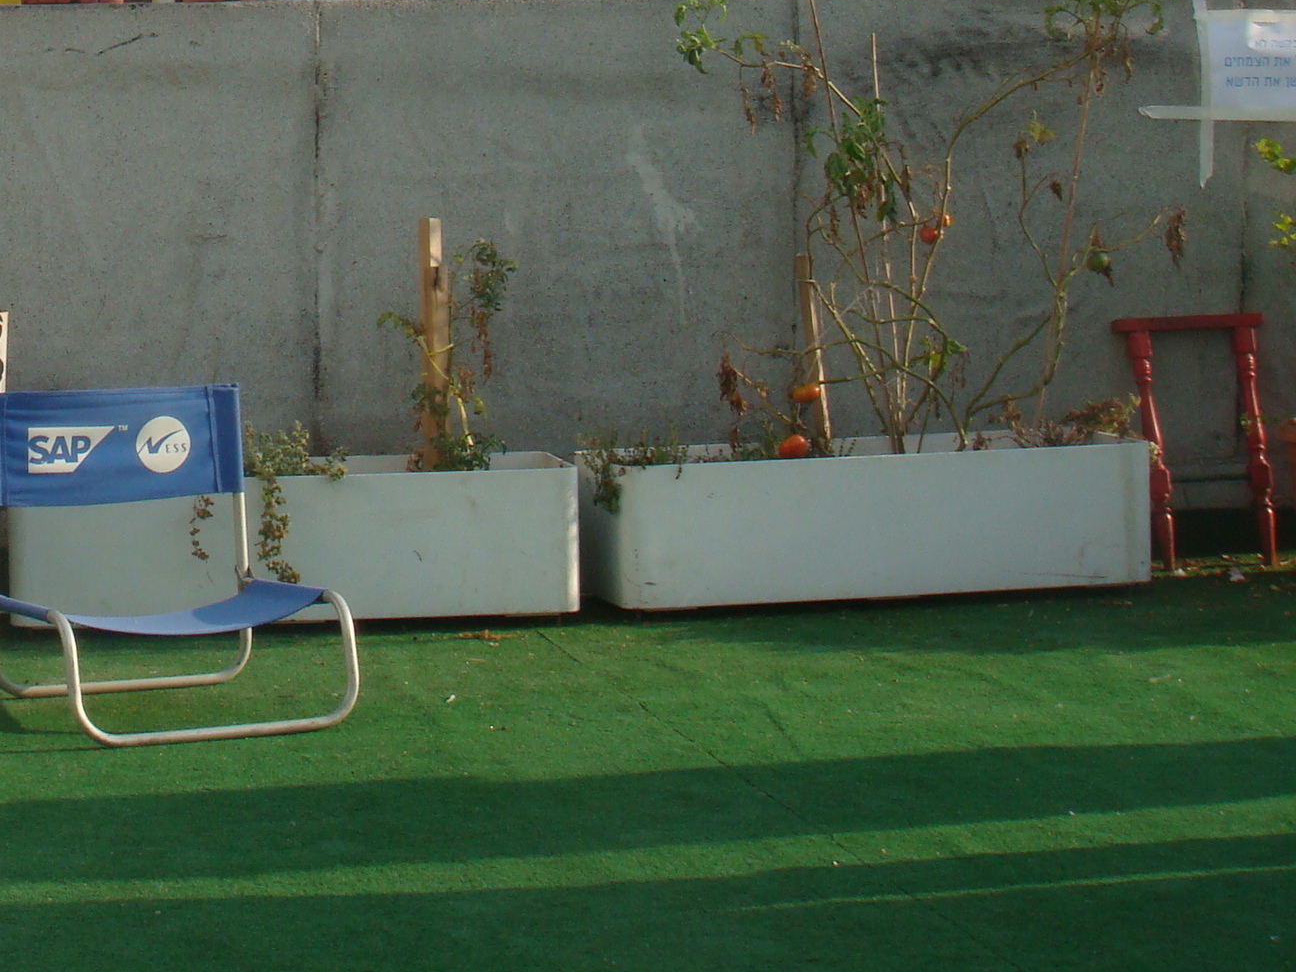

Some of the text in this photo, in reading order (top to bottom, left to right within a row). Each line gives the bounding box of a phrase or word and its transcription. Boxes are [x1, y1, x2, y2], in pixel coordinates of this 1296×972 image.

[1224, 56, 1291, 68] את הצמחים
[1226, 76, 1259, 88] הדשא
[1264, 76, 1280, 88] את
[28, 435, 91, 464] SAP
